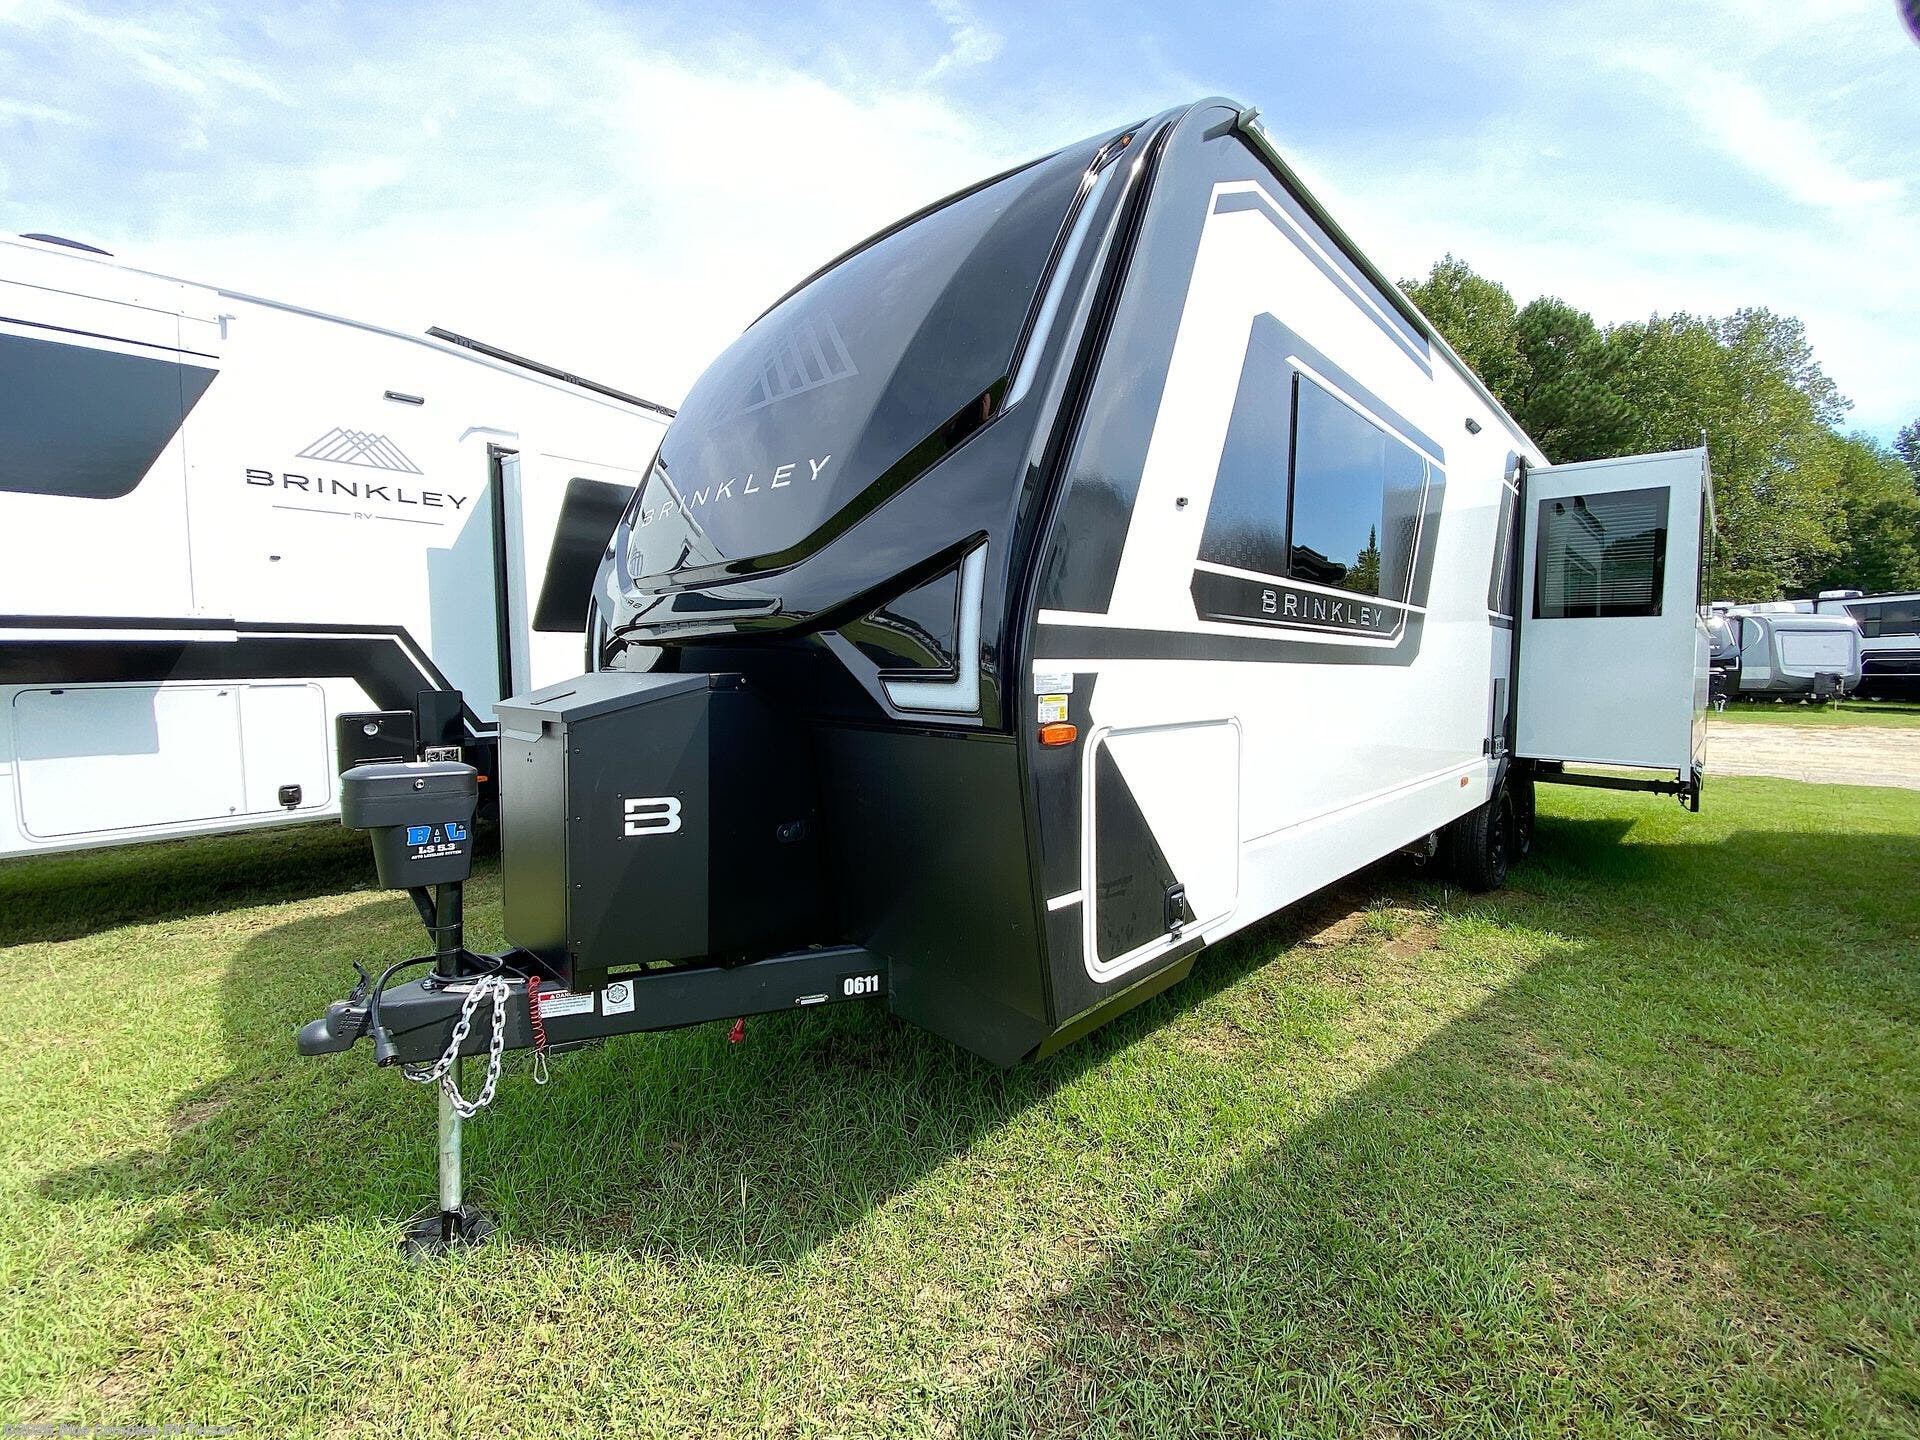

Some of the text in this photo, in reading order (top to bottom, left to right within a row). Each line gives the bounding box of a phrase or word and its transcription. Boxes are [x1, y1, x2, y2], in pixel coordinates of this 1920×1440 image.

[246, 468, 467, 510] BRINKLEY
[641, 454, 832, 528] BRINKLEY
[353, 511, 373, 520] RV
[1261, 590, 1382, 627] BRINKLEY
[624, 796, 682, 836] B
[418, 845, 436, 854] LS
[843, 974, 879, 996] 0611
